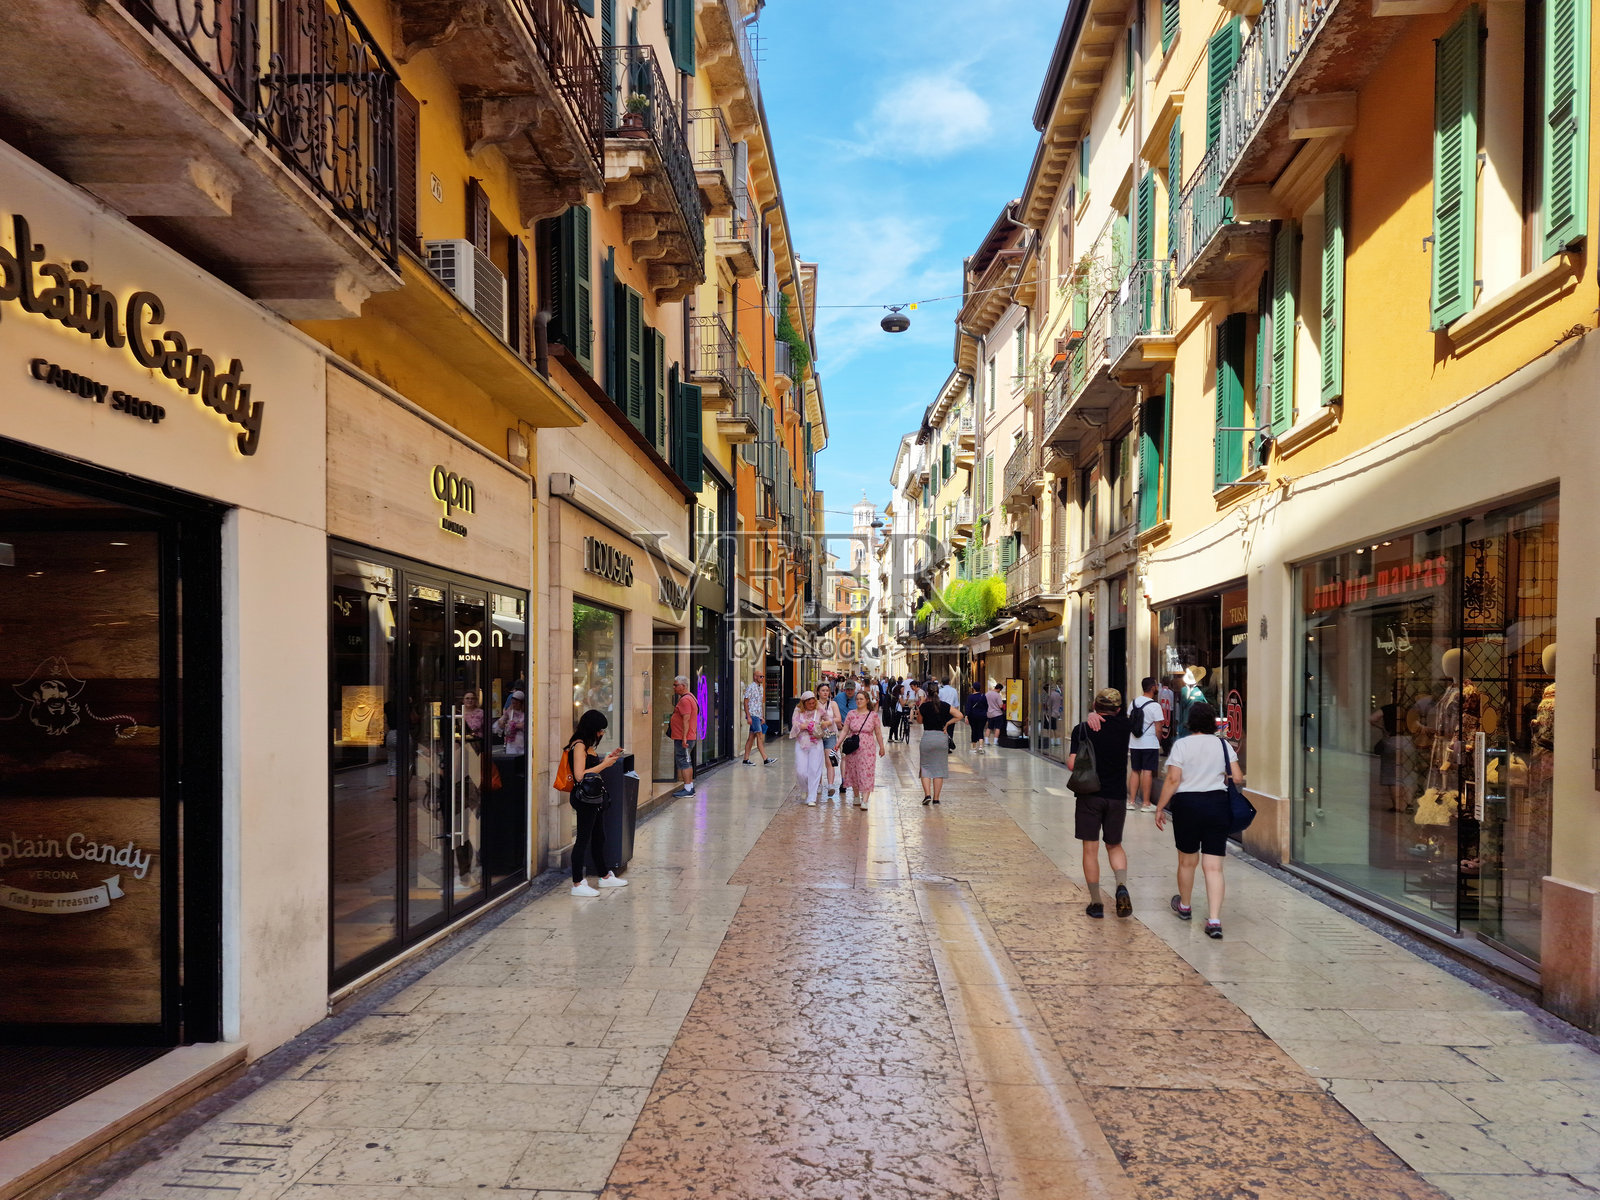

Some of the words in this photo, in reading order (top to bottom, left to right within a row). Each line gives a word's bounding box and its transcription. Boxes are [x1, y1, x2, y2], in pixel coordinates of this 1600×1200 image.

[30, 358, 108, 403] CANDY
[111, 391, 166, 423] SHOP
[126, 291, 264, 456] Candy
[583, 536, 634, 588] DOUGLAS
[1314, 569, 1368, 609] antonio
[1377, 555, 1446, 597] marras
[1227, 703, 1243, 740] 50
[30, 870, 79, 880] VERONA
[66, 832, 151, 880] Candy
